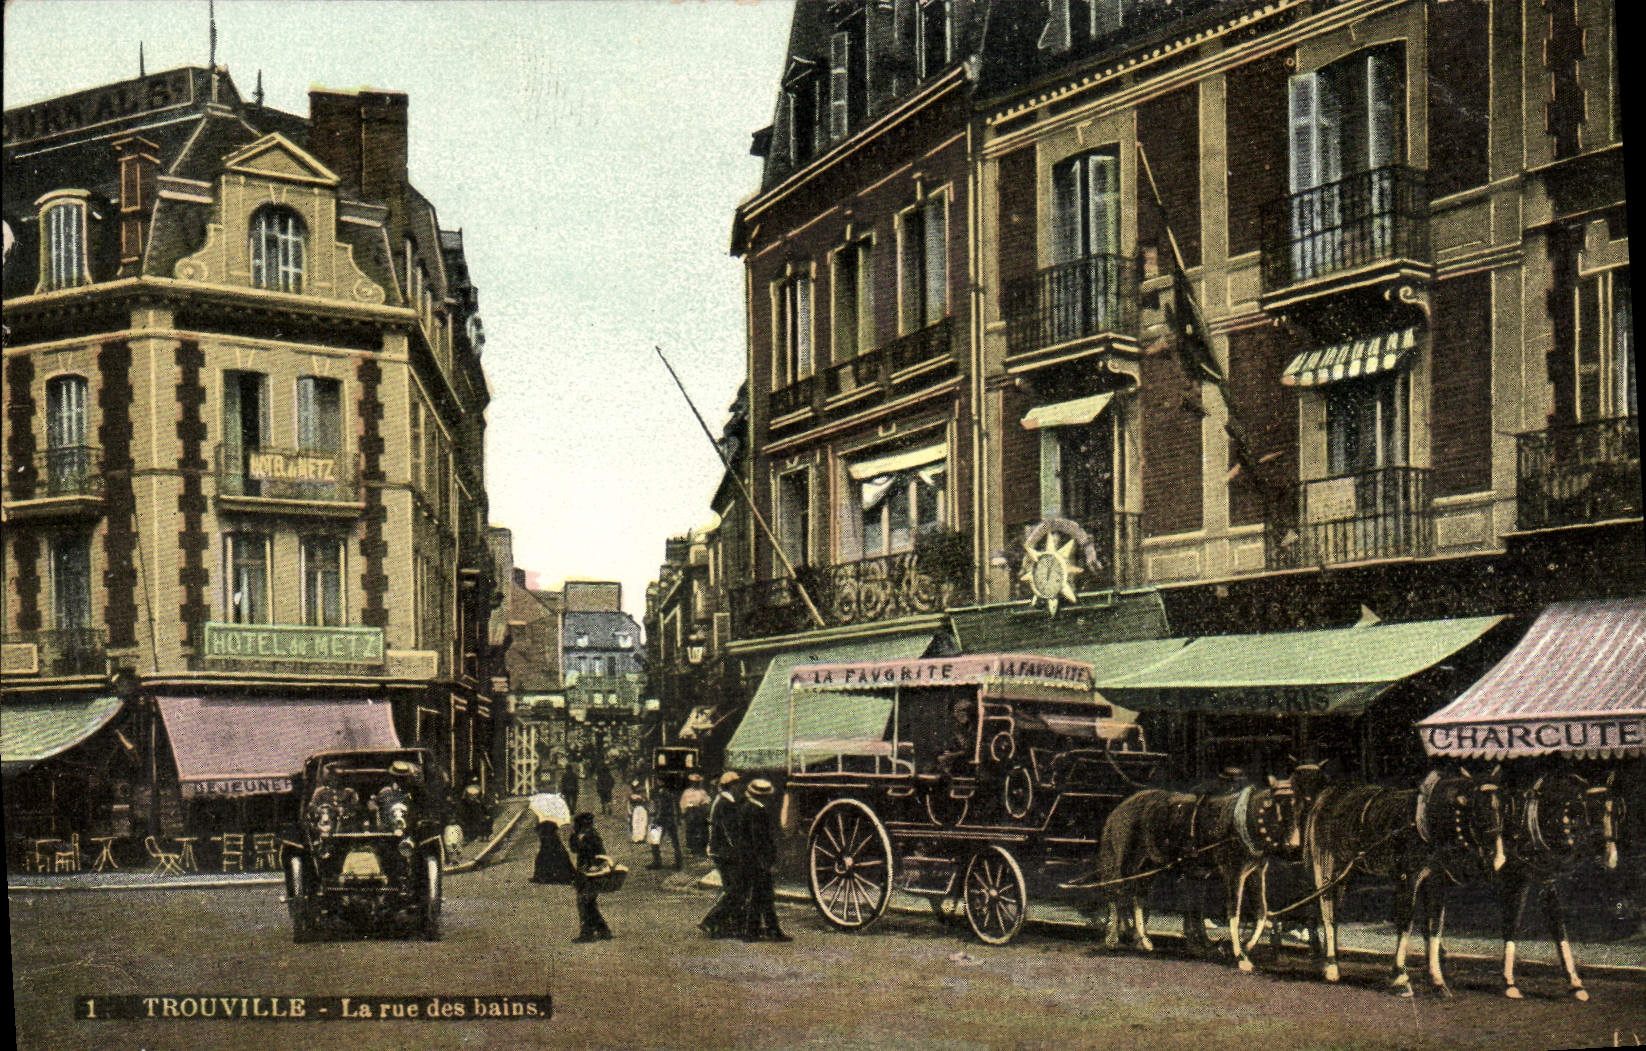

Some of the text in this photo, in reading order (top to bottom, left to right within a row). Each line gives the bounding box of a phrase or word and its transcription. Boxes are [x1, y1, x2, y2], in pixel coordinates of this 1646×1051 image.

[212, 630, 285, 655] HOTEL
[313, 632, 377, 658] METZ
[814, 664, 953, 684] LA FAVORITE
[1019, 661, 1085, 681] FAVORITE
[1429, 720, 1643, 750] CHARCUTE
